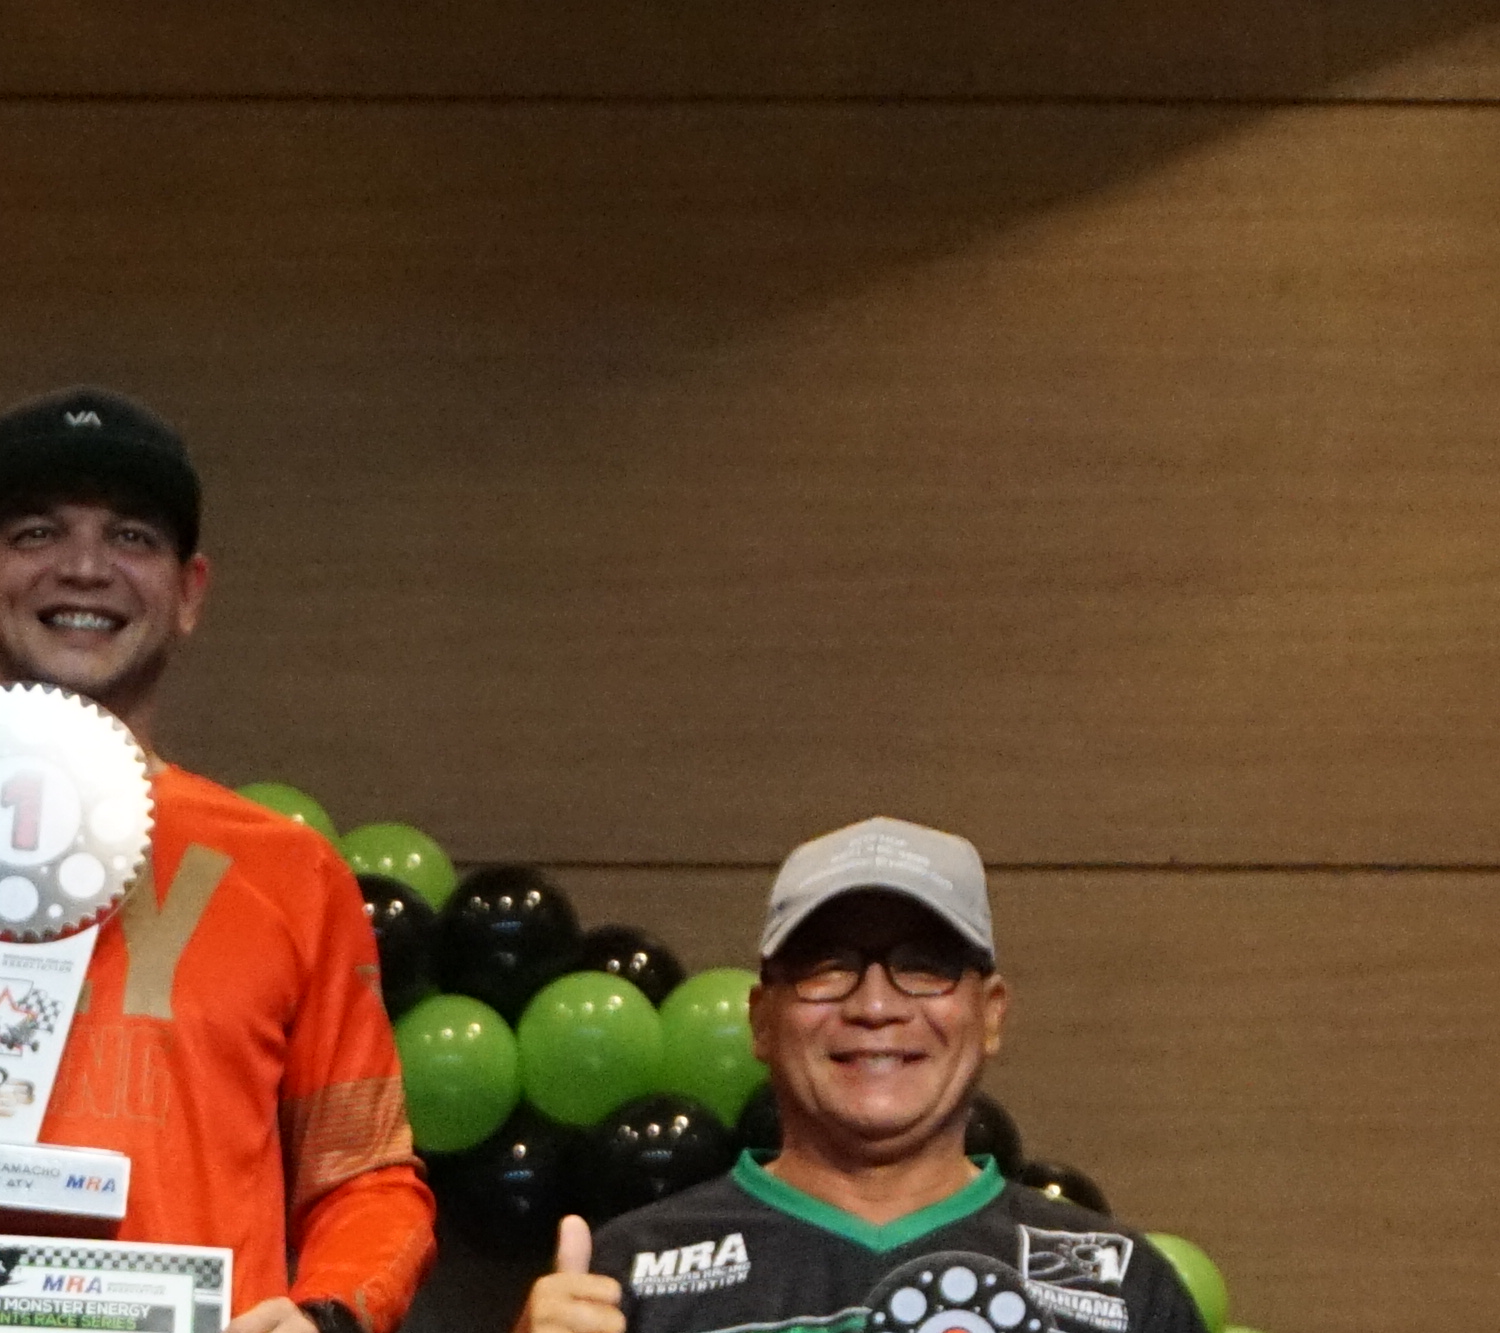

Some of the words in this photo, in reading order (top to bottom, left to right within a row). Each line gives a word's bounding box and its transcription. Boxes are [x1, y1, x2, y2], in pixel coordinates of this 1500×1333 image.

[0, 772, 45, 851] 1
[65, 1175, 116, 1193] MRA
[633, 1232, 749, 1279] MRA
[42, 1273, 102, 1294] MRA
[4, 1298, 85, 1314] MONSTER
[86, 1301, 151, 1319] ENERGY
[34, 1312, 78, 1327] RACE
[80, 1315, 137, 1331] SERIES
